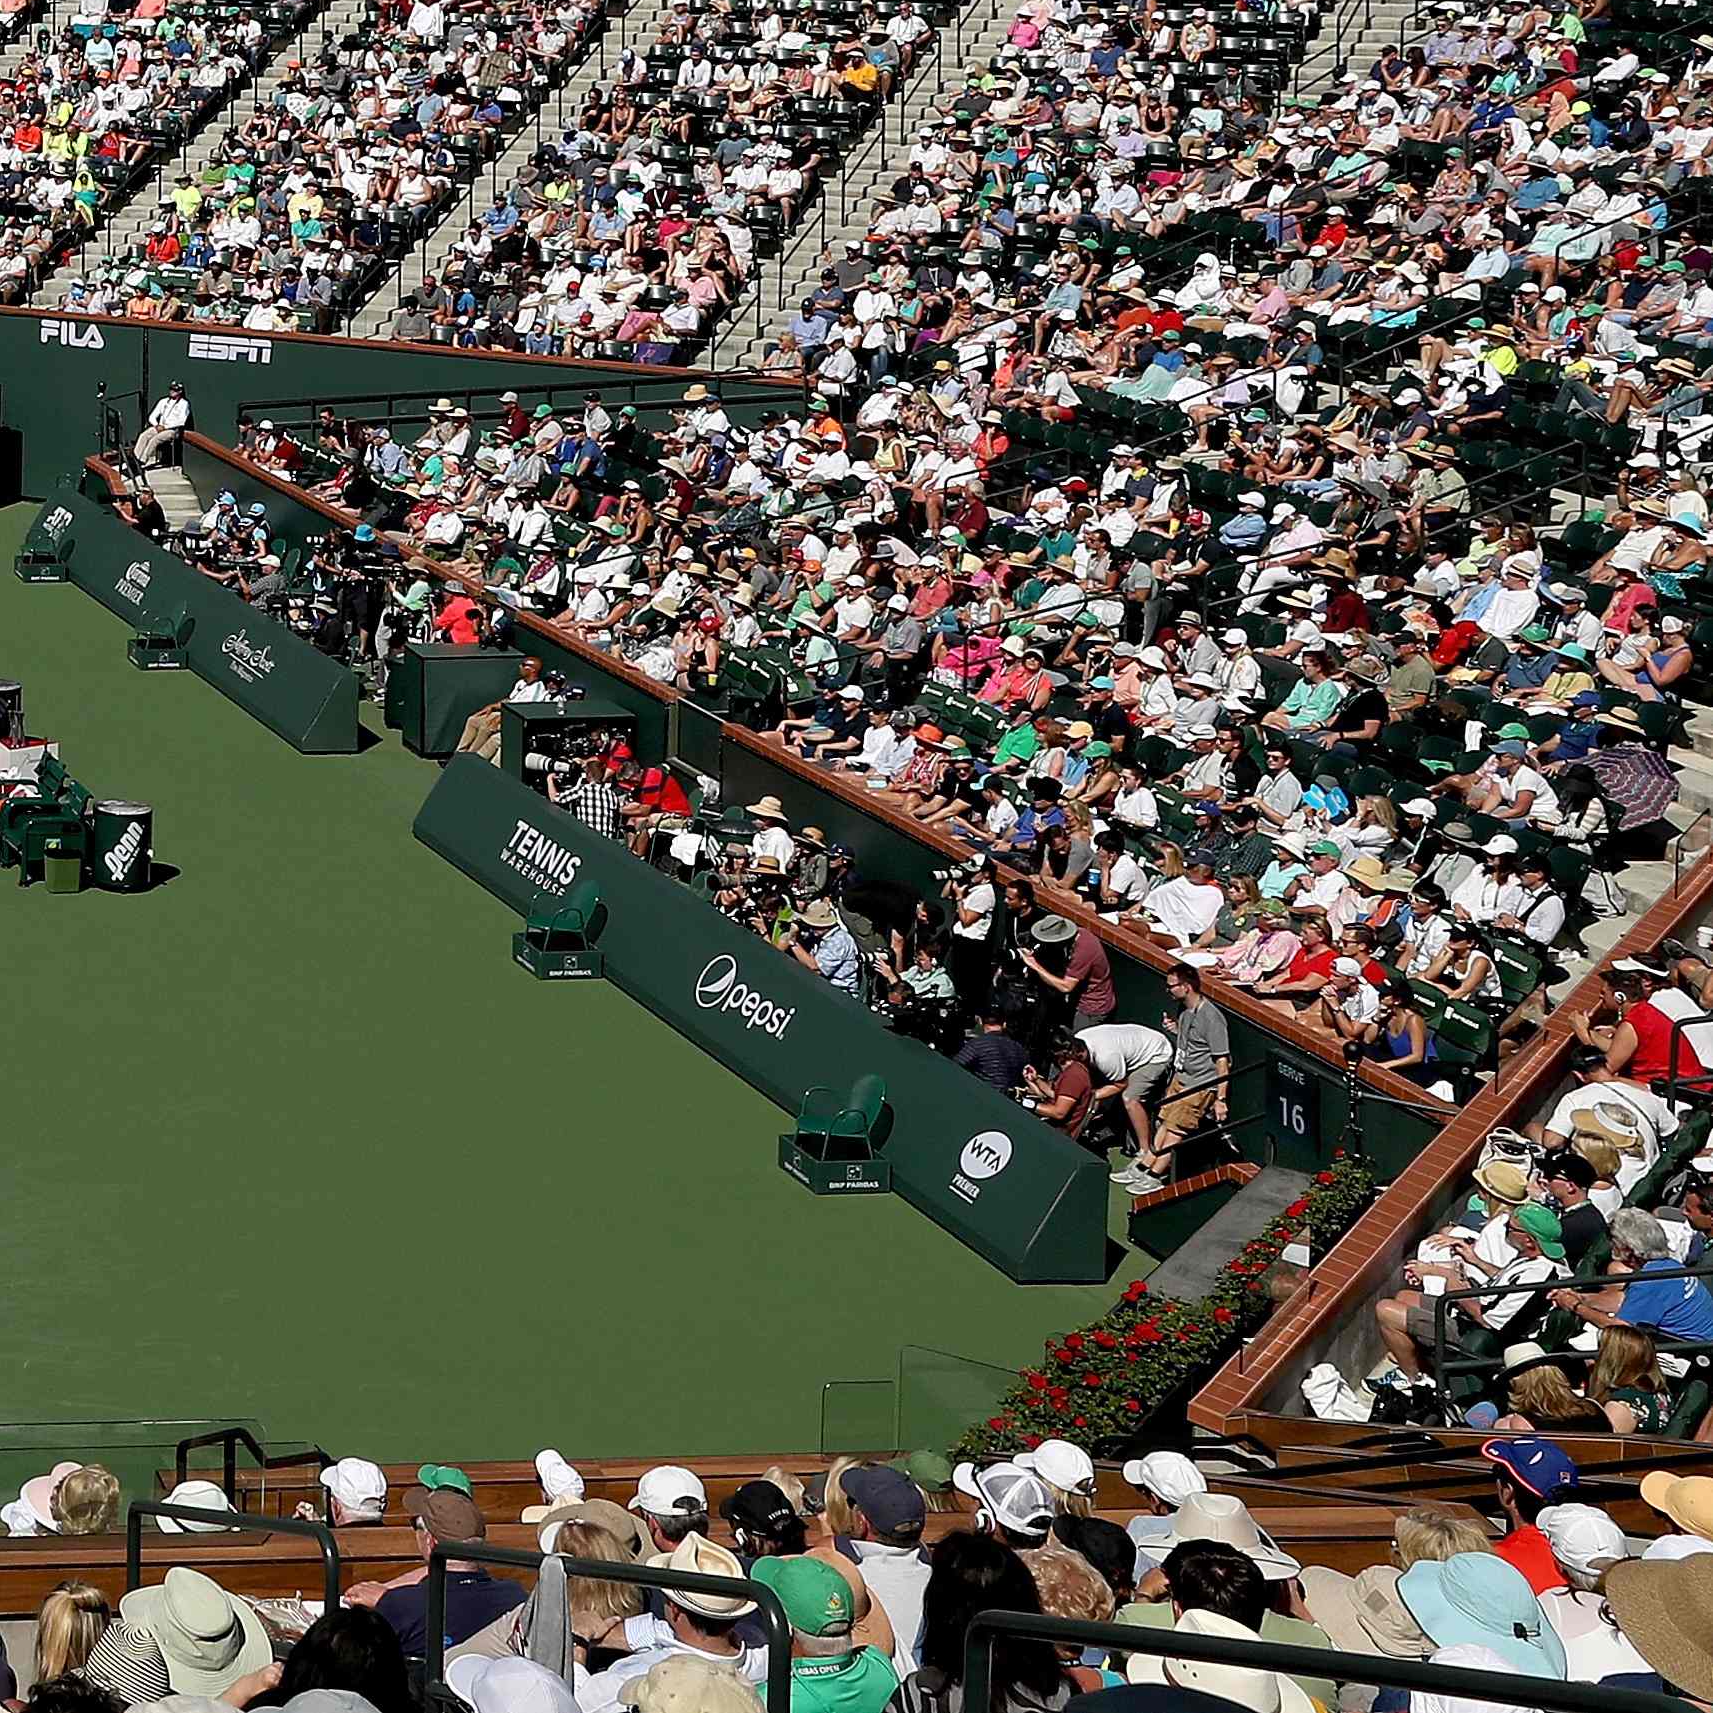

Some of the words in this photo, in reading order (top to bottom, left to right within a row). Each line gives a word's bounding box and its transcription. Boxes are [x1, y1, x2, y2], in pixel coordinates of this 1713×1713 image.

[40, 319, 105, 349] FILA
[188, 333, 273, 365] ESPN
[508, 819, 582, 886] TENNIS
[500, 847, 566, 897] WAREHOUSE
[721, 983, 795, 1039] pepsi
[1277, 1062, 1307, 1086] SERVE
[1279, 1095, 1305, 1135] 16
[969, 1138, 1002, 1172] WTA
[820, 1663, 840, 1674] OPEN
